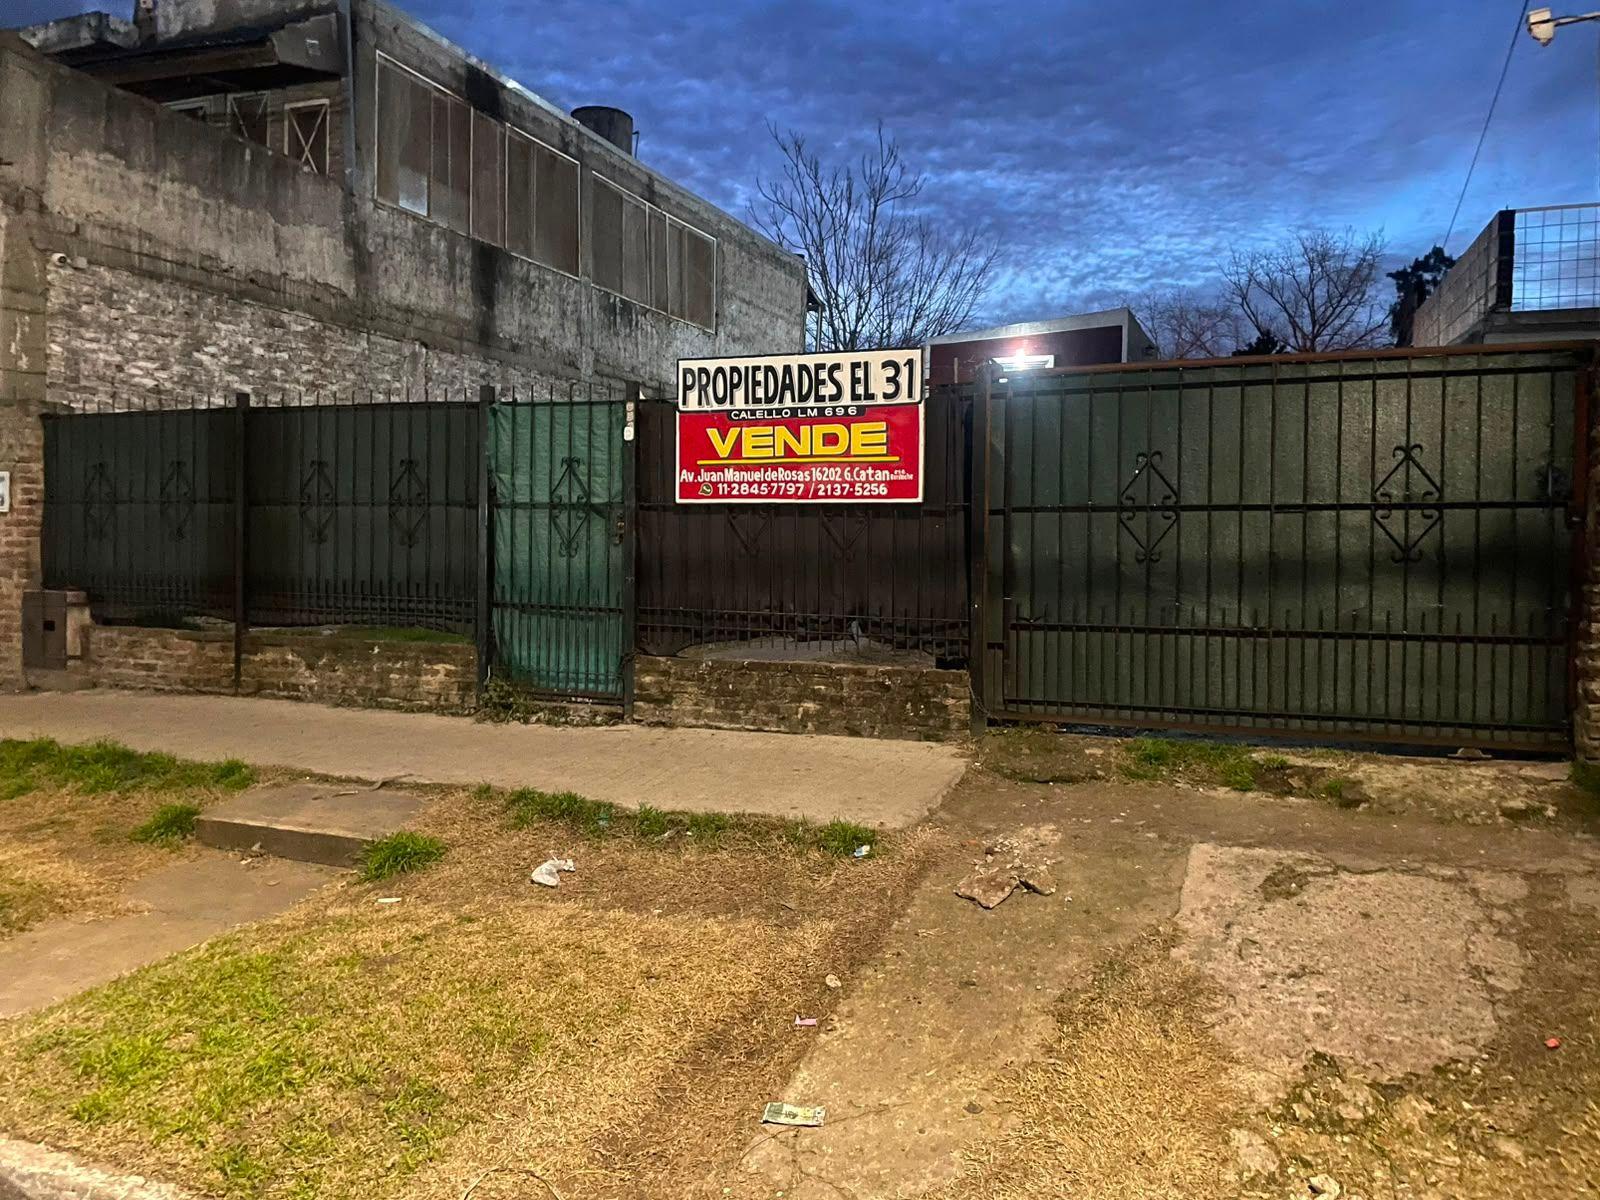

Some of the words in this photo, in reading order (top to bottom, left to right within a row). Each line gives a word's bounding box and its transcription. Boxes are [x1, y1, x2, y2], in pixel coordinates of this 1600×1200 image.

[682, 363, 843, 408] PROPIEDADES
[850, 361, 876, 401] EL
[880, 358, 915, 400] 31
[731, 409, 791, 419] CALELLO
[797, 407, 818, 417] LM
[824, 406, 857, 416] 696
[706, 422, 887, 458] VENDE
[811, 467, 842, 481] 16202
